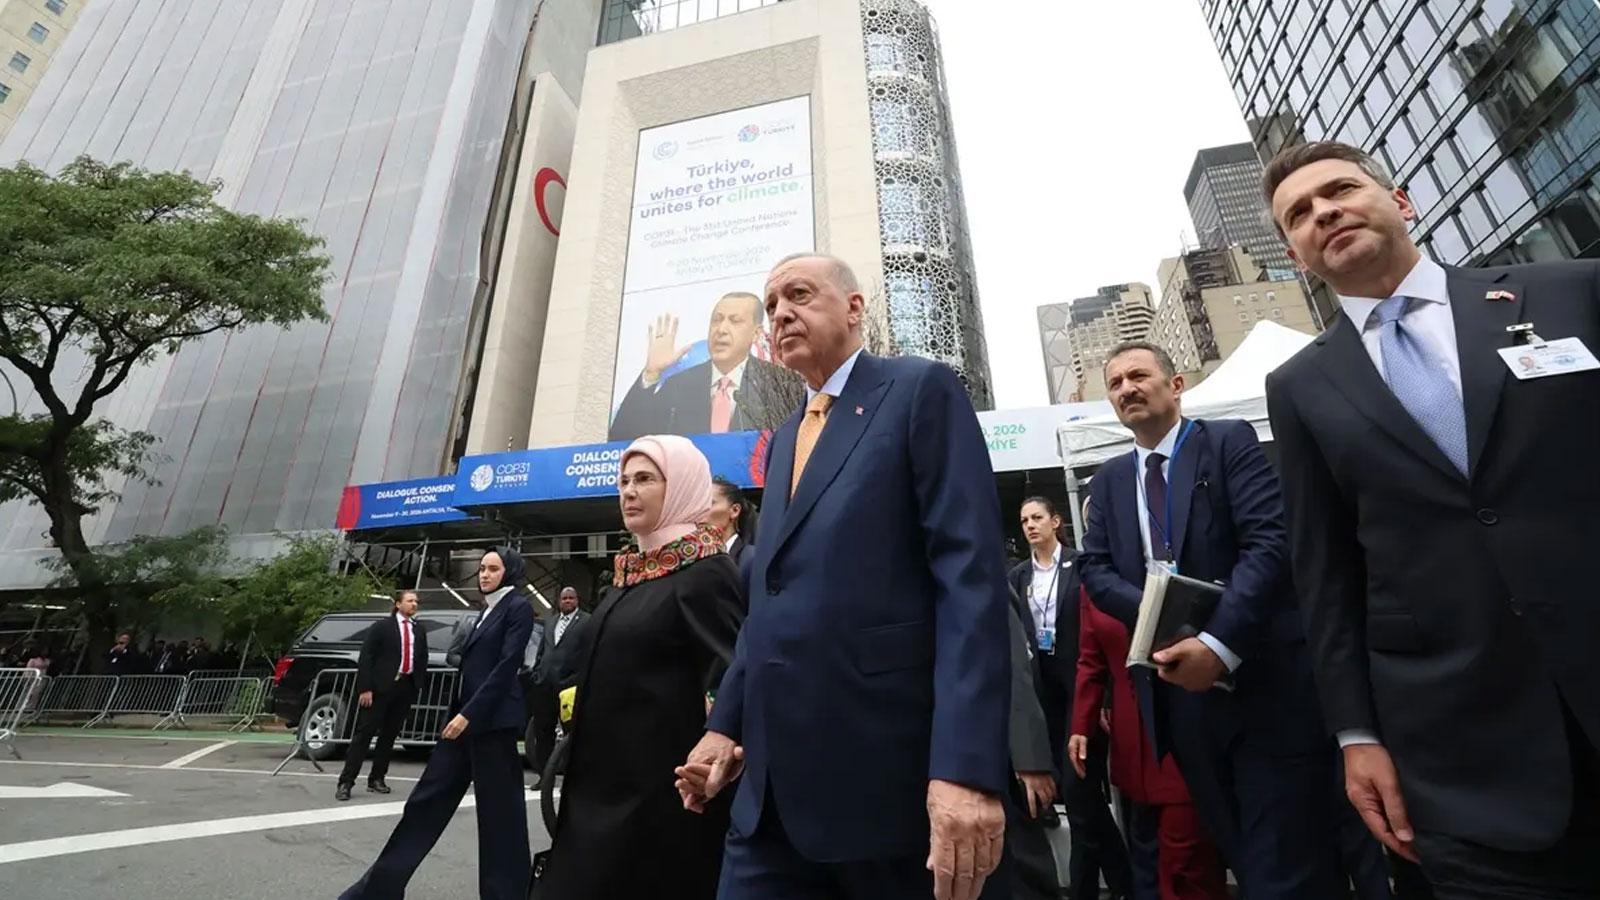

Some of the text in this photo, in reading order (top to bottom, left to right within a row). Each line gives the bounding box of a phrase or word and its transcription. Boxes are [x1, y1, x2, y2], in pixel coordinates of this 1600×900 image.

[687, 158, 755, 179] Türkiye,
[650, 163, 794, 201] where the world
[640, 180, 804, 219] unites for climate.
[994, 424, 1026, 436] 2026
[496, 462, 531, 475] COP31
